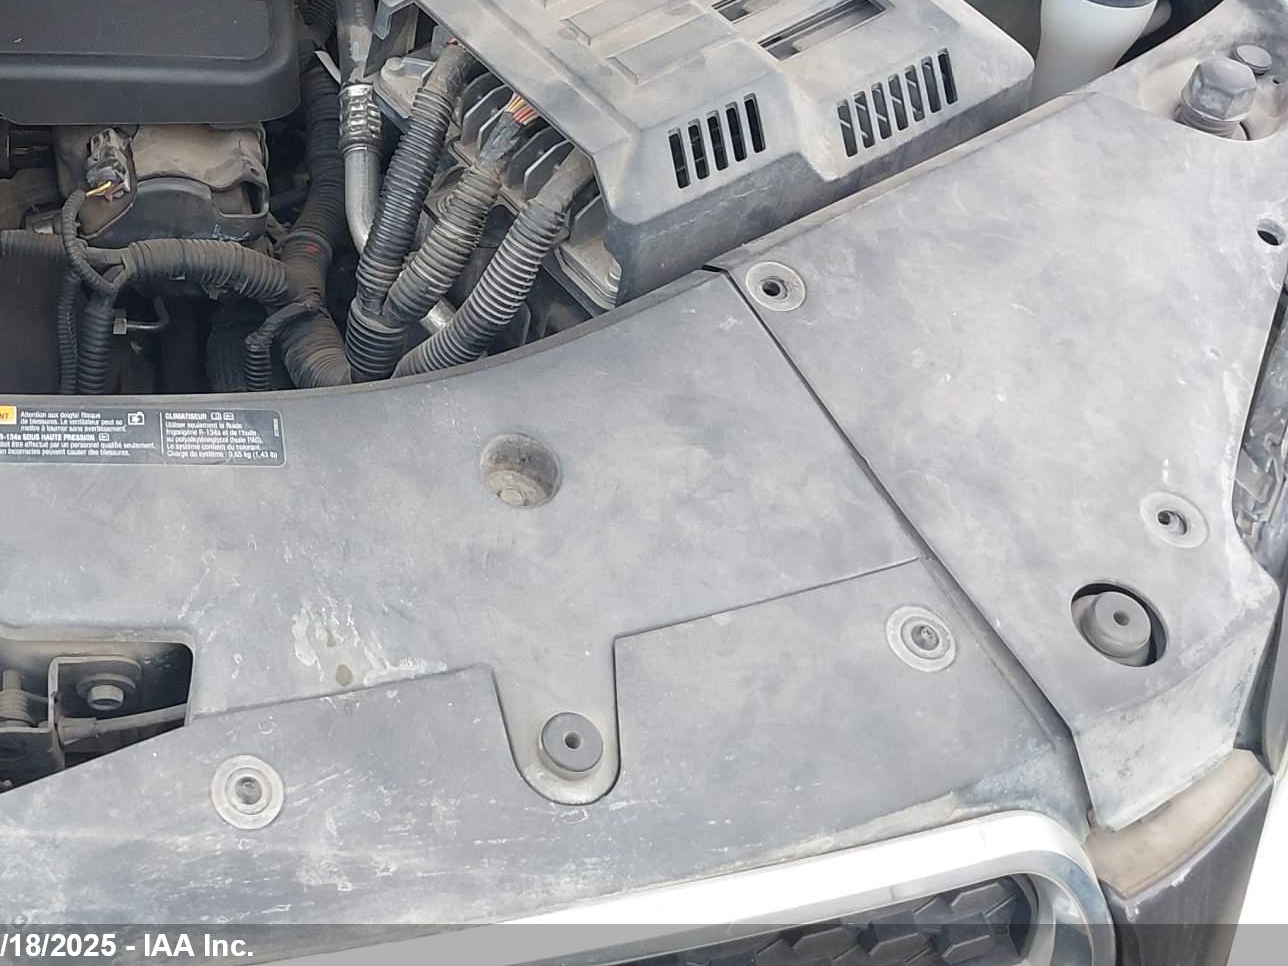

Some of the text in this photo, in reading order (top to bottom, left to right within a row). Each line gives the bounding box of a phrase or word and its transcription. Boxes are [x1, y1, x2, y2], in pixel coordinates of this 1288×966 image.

[165, 412, 208, 420] CLIMATISEUR
[22, 432, 40, 440] SOUS
[42, 433, 62, 441] HAUTE
[64, 433, 95, 441] PRESSION
